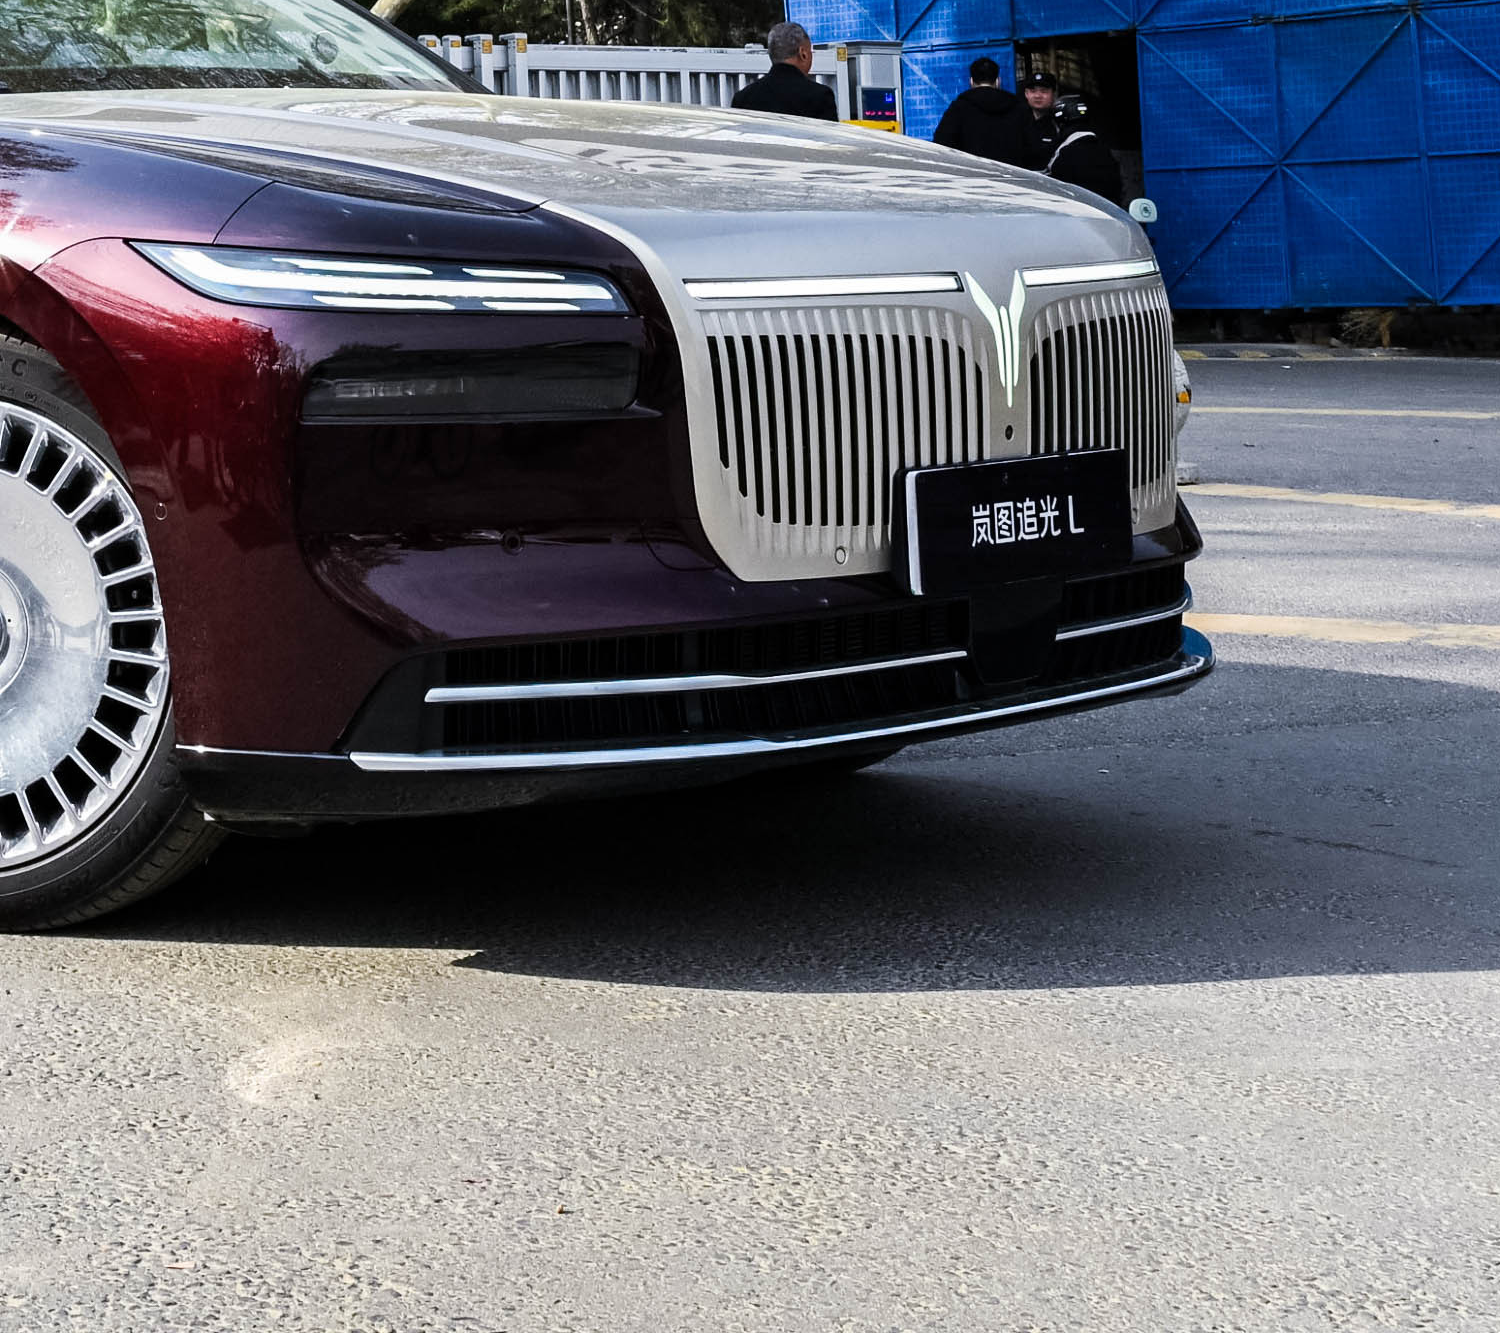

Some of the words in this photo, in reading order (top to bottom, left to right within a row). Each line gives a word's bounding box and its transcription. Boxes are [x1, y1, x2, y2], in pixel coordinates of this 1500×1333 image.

[11, 358, 28, 377] C
[970, 494, 1061, 548] 岚图追光
[1068, 495, 1084, 534] L
